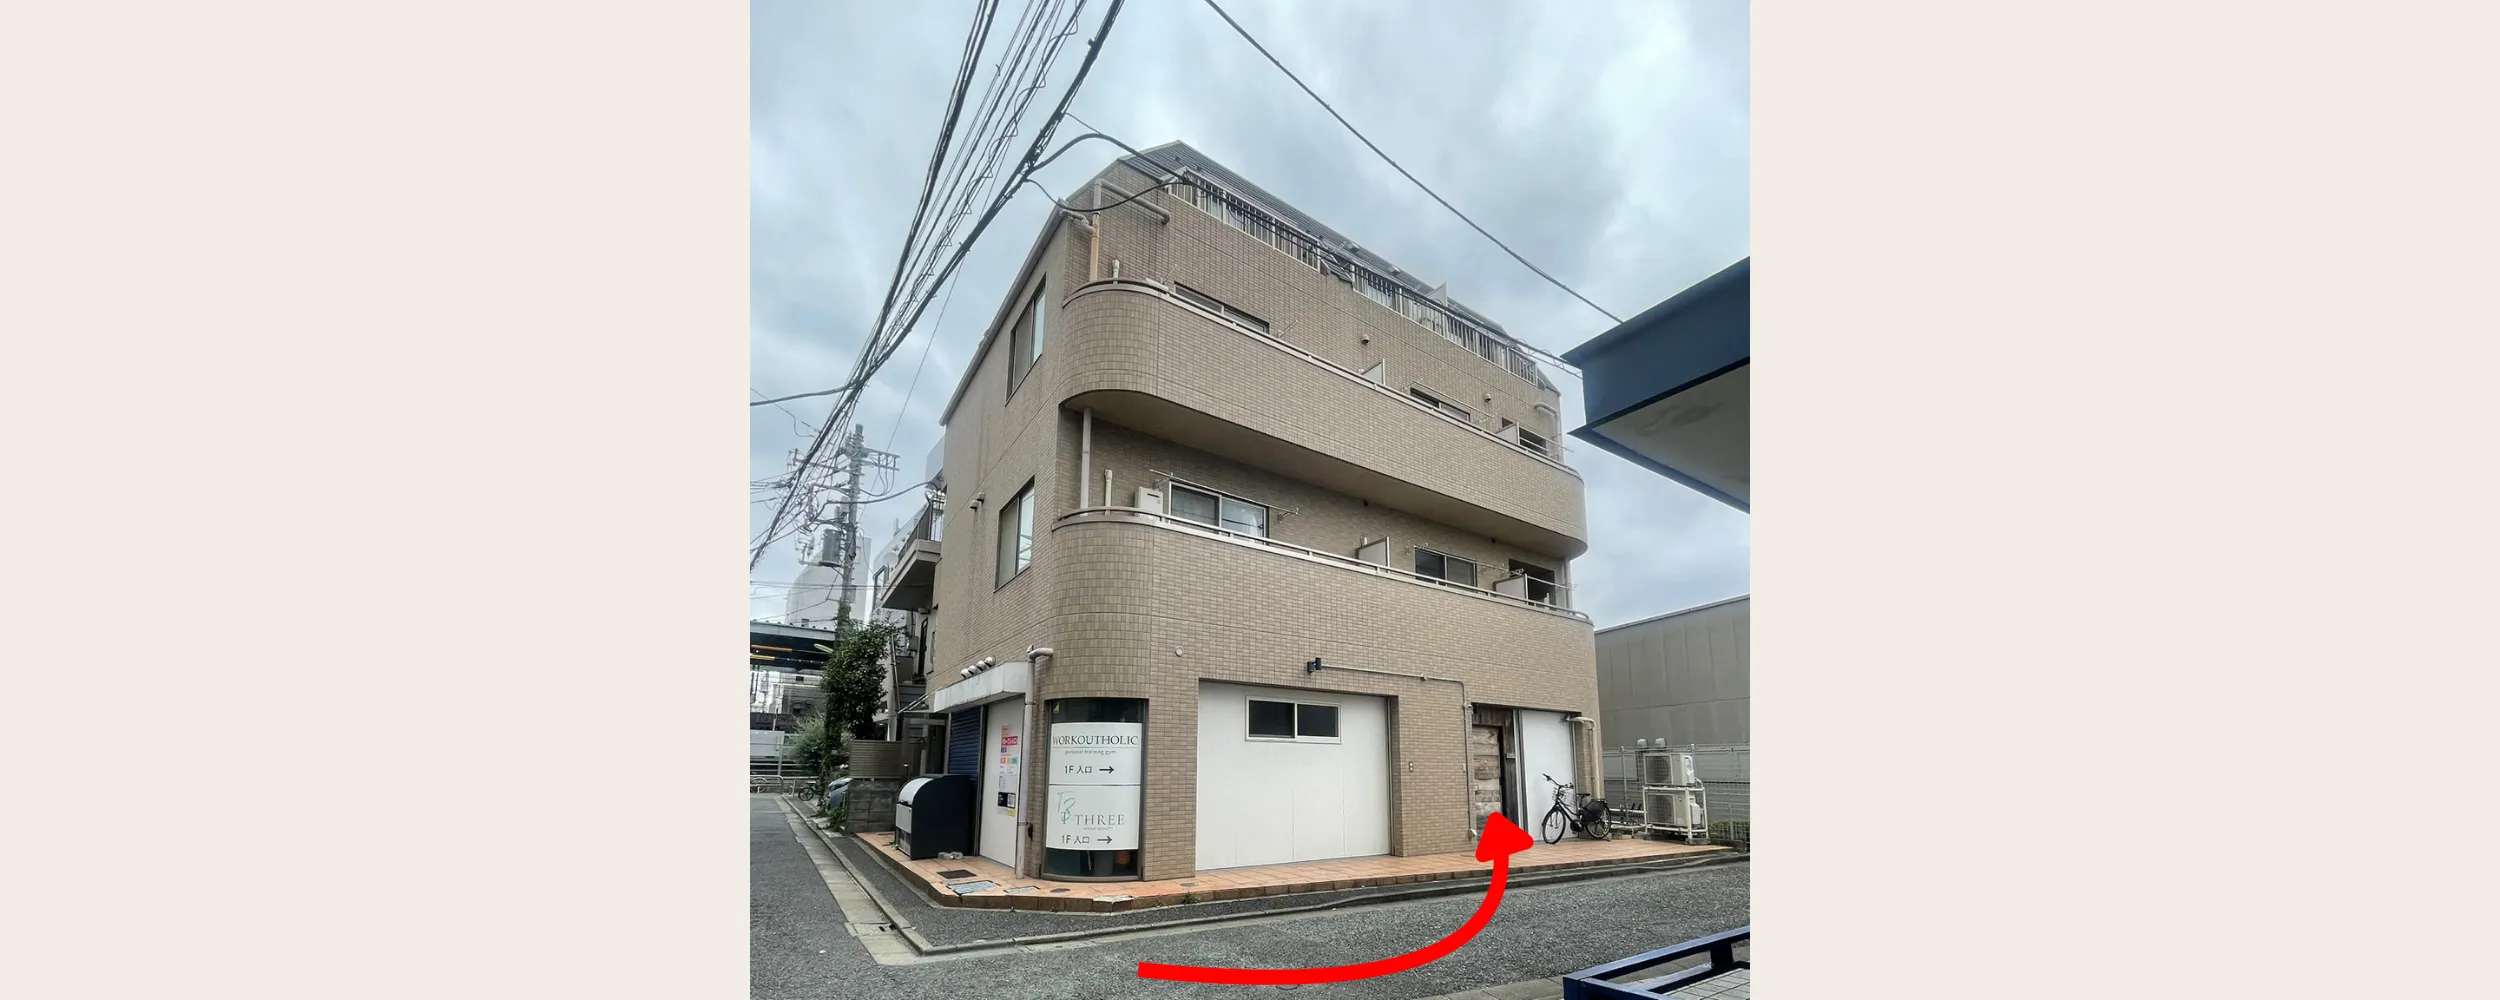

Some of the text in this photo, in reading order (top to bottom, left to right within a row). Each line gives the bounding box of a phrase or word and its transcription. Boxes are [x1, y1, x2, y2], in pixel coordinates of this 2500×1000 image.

[1052, 735, 1139, 745] WORKOUTHOLIC
[1064, 765, 1093, 774] 1F 入口
[1074, 814, 1125, 826] THREE
[1061, 834, 1090, 844] 1F 入口
